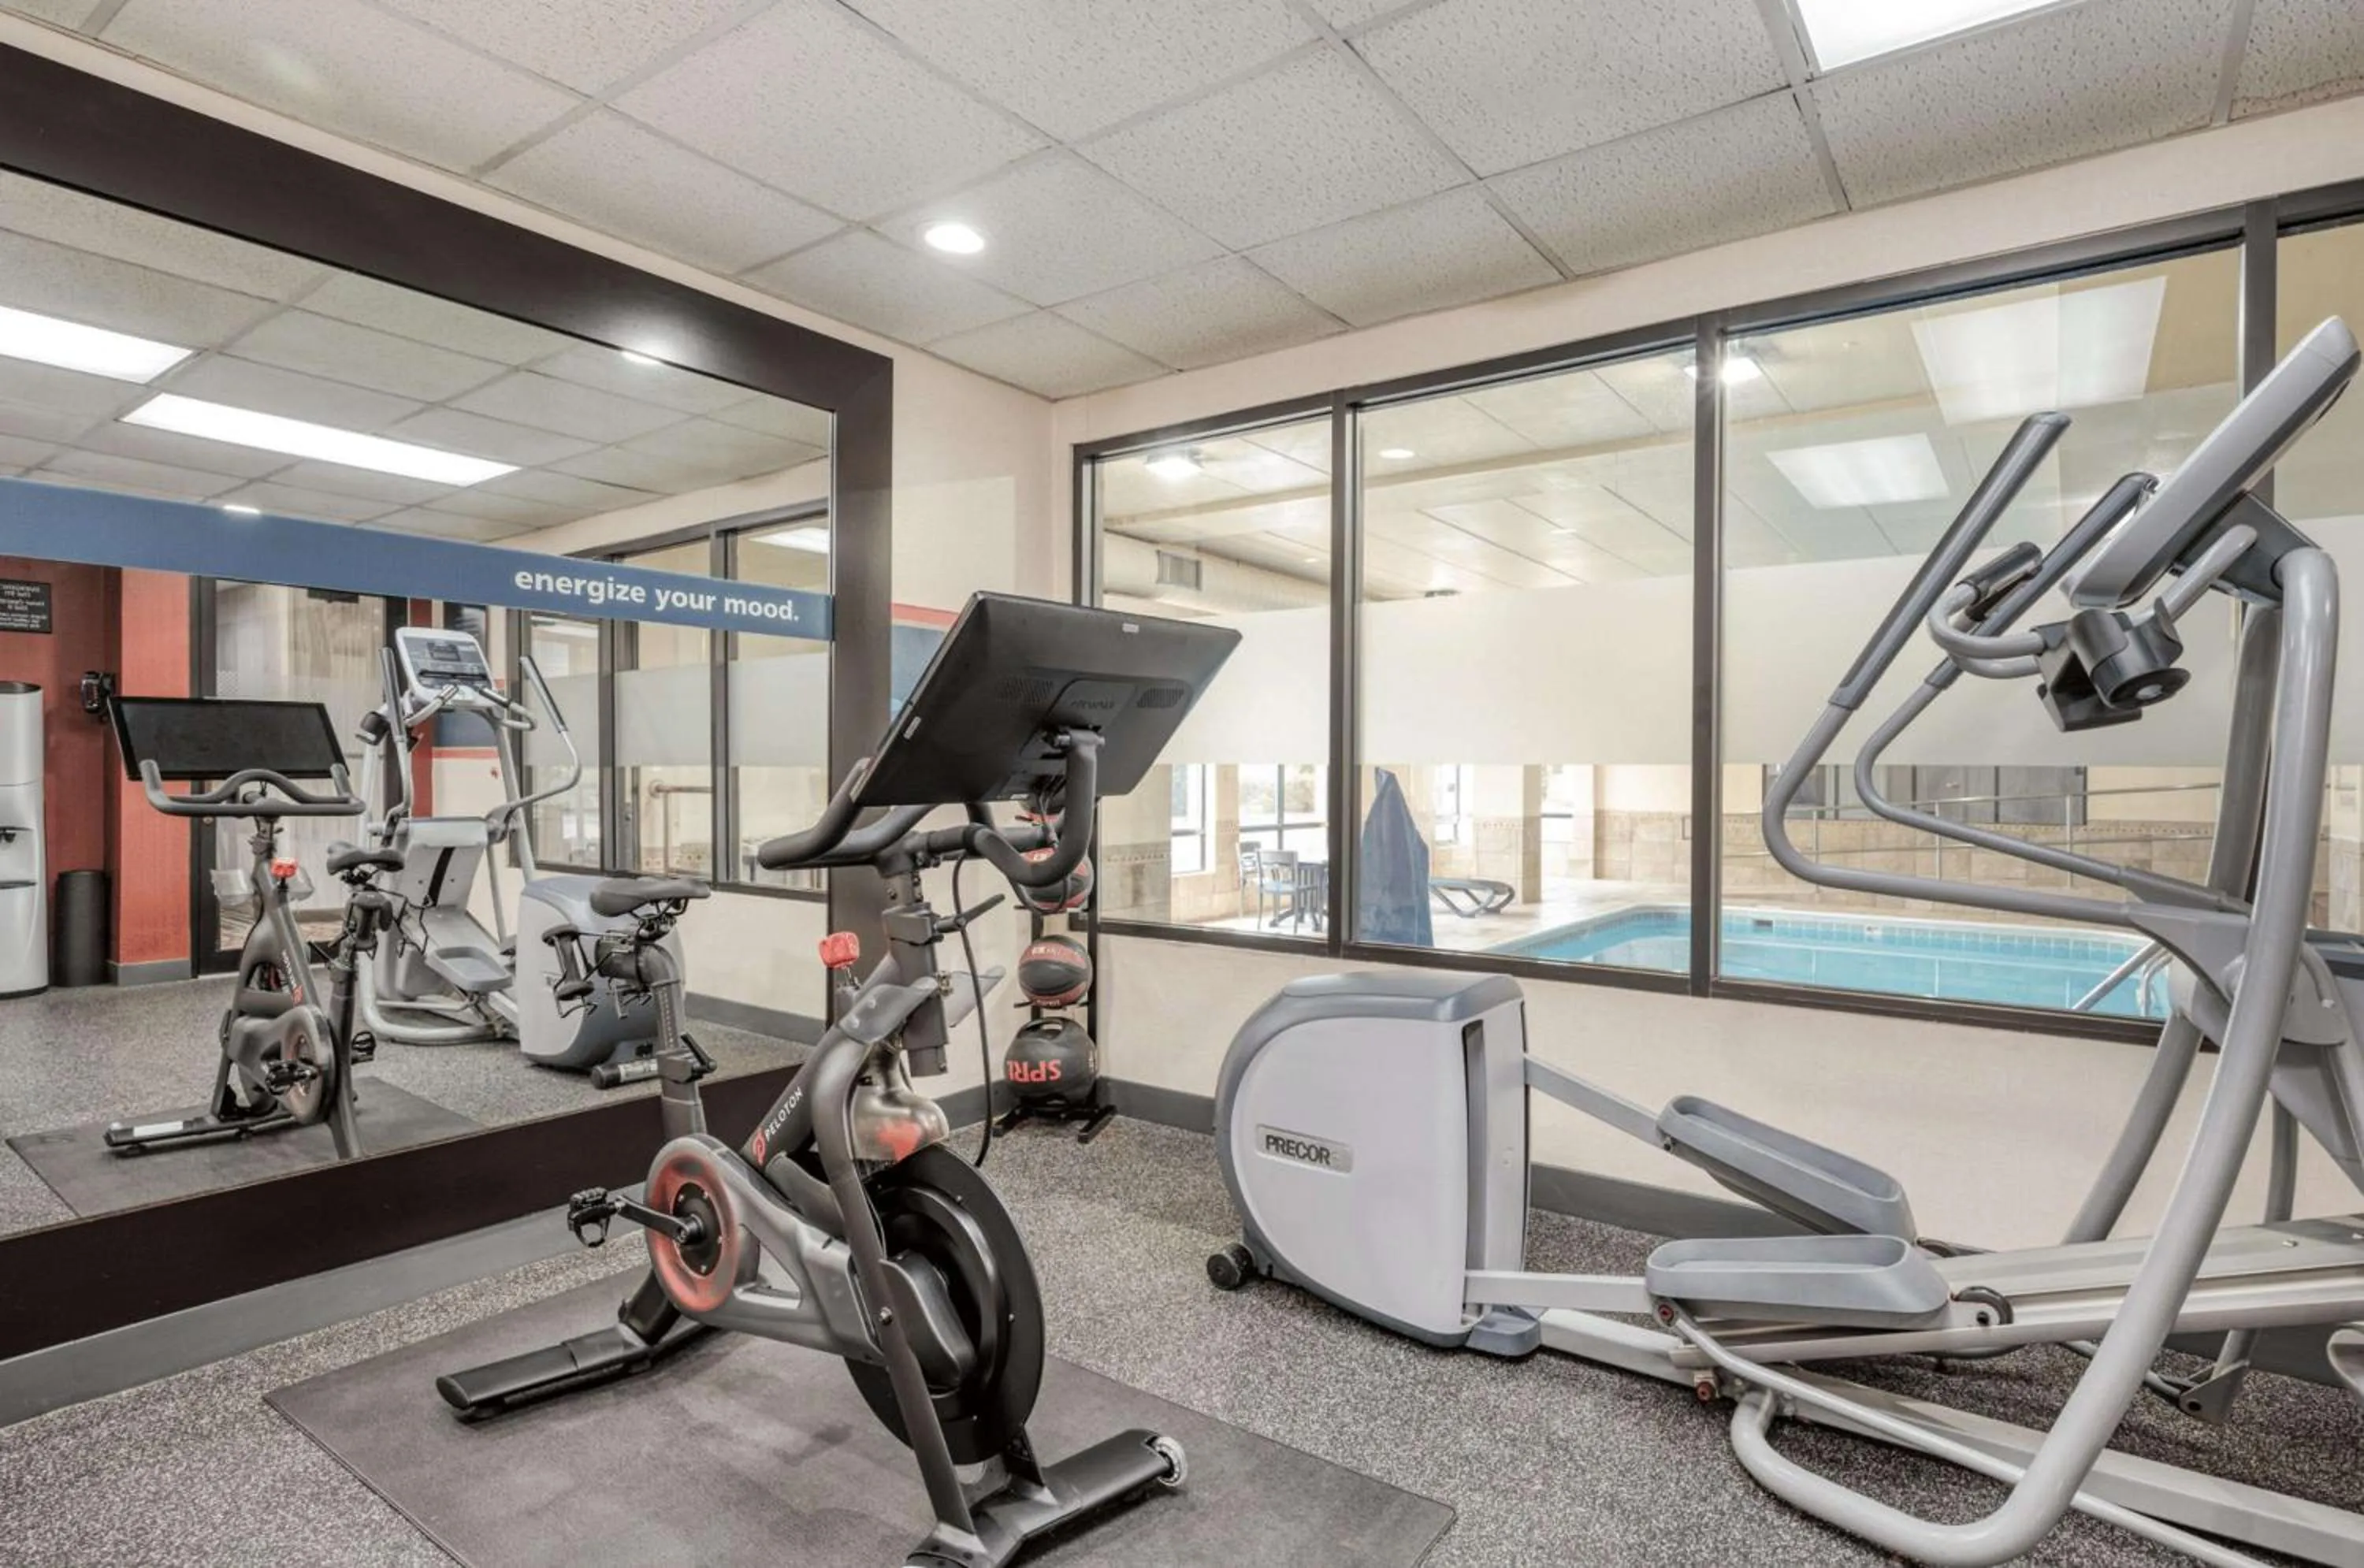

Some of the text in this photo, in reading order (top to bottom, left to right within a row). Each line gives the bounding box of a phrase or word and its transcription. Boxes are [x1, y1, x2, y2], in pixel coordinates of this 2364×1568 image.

[514, 570, 800, 621] energize your mood.
[764, 1087, 803, 1141] PELOTON
[1266, 1135, 1331, 1165] PRECOR
